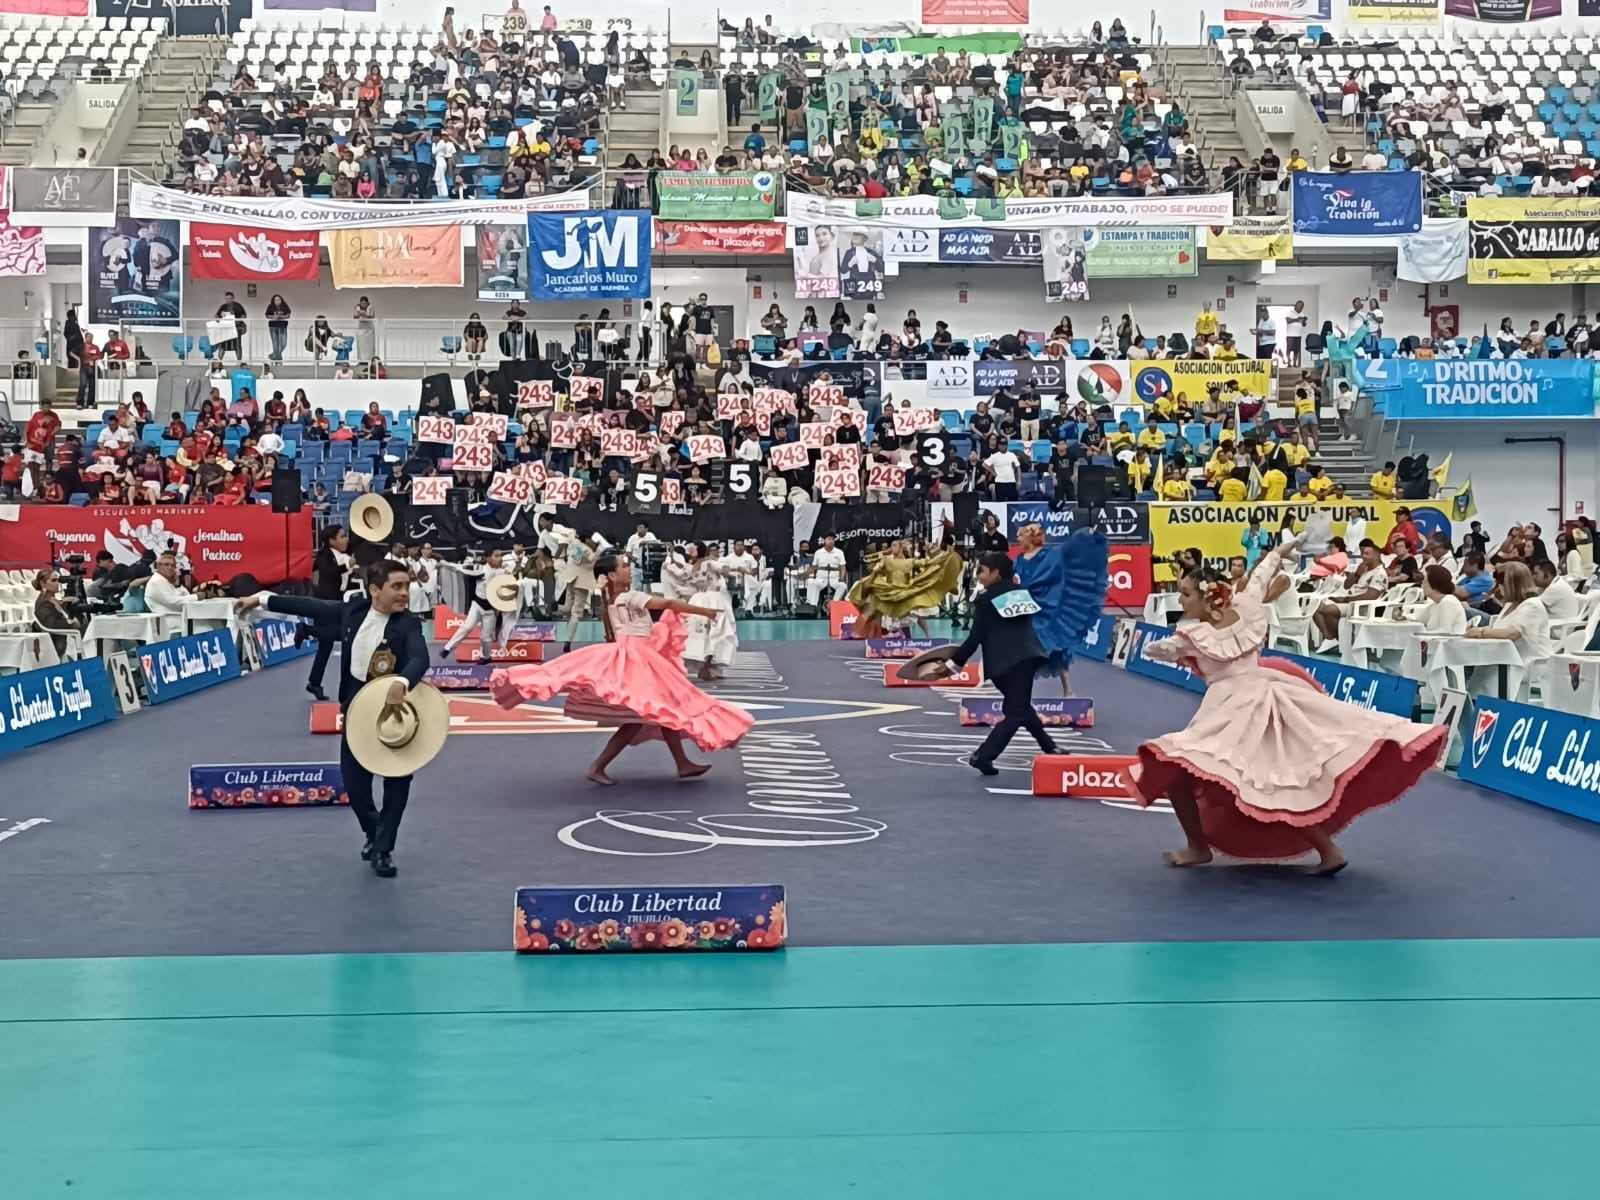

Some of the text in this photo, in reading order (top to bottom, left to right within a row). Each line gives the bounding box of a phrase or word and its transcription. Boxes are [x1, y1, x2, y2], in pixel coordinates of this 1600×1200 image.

[503, 16, 527, 30] 238
[89, 99, 117, 109] SALIDA
[1257, 106, 1284, 114] SALIDA
[202, 203, 223, 214] EN
[223, 205, 239, 215] EL
[241, 206, 298, 221] CALLAO,
[301, 210, 330, 220] CON
[1054, 205, 1062, 214] Y
[1064, 205, 1128, 216] TRABAJO,
[1170, 204, 1184, 214] SE
[1186, 203, 1229, 214] PUEDE!
[1325, 206, 1380, 220] Tradición
[943, 233, 995, 244] AD LA NOTA
[1101, 229, 1190, 241] ESTAMPA Y TRADICIÓN
[1517, 227, 1600, 252] CABALLO de
[946, 246, 990, 256] MAS ALTA
[544, 271, 639, 288] Jancarlos Muro
[857, 280, 882, 293] 249
[1061, 281, 1087, 294] 249
[976, 369, 1019, 377] AD LA NOTA
[1225, 360, 1266, 375] CULTURAL
[1434, 360, 1534, 383] D'RITMO Y
[979, 378, 1016, 387] MAS ALTA
[519, 382, 553, 405] 243
[810, 387, 843, 406] 243
[1421, 380, 1539, 406] TRADICIÓN
[420, 419, 453, 440] 243
[602, 433, 635, 452] 243
[690, 438, 724, 458] 243
[453, 445, 492, 467] 243
[773, 445, 807, 467] 243
[922, 438, 945, 466] 3
[729, 463, 752, 493] 5
[822, 474, 858, 494] 243
[870, 466, 905, 488] 243
[491, 476, 530, 501] 243
[546, 480, 581, 501] 243
[634, 472, 658, 502] 5
[93, 509, 136, 517] ESCUELA
[156, 507, 206, 515] MARINERA
[1011, 510, 1075, 523] AD LA NOTA
[45, 528, 244, 545] Dayanna Jonathan
[1045, 525, 1070, 537] ALTA
[202, 548, 243, 562] Pacheco
[1003, 602, 1039, 617] 0229
[903, 639, 932, 648] Libertad
[1116, 627, 1131, 659] 2
[158, 635, 227, 685] Club Libertad Trujillo
[436, 667, 473, 676] Libertad
[120, 663, 135, 704] 3
[9, 677, 56, 731] Libertad
[53, 668, 92, 721] Trujillo
[1502, 716, 1600, 796] Club Liber
[224, 768, 324, 785] Club Libertad
[574, 891, 722, 914] Club Libertad
[627, 914, 671, 924] TRUJILLO
